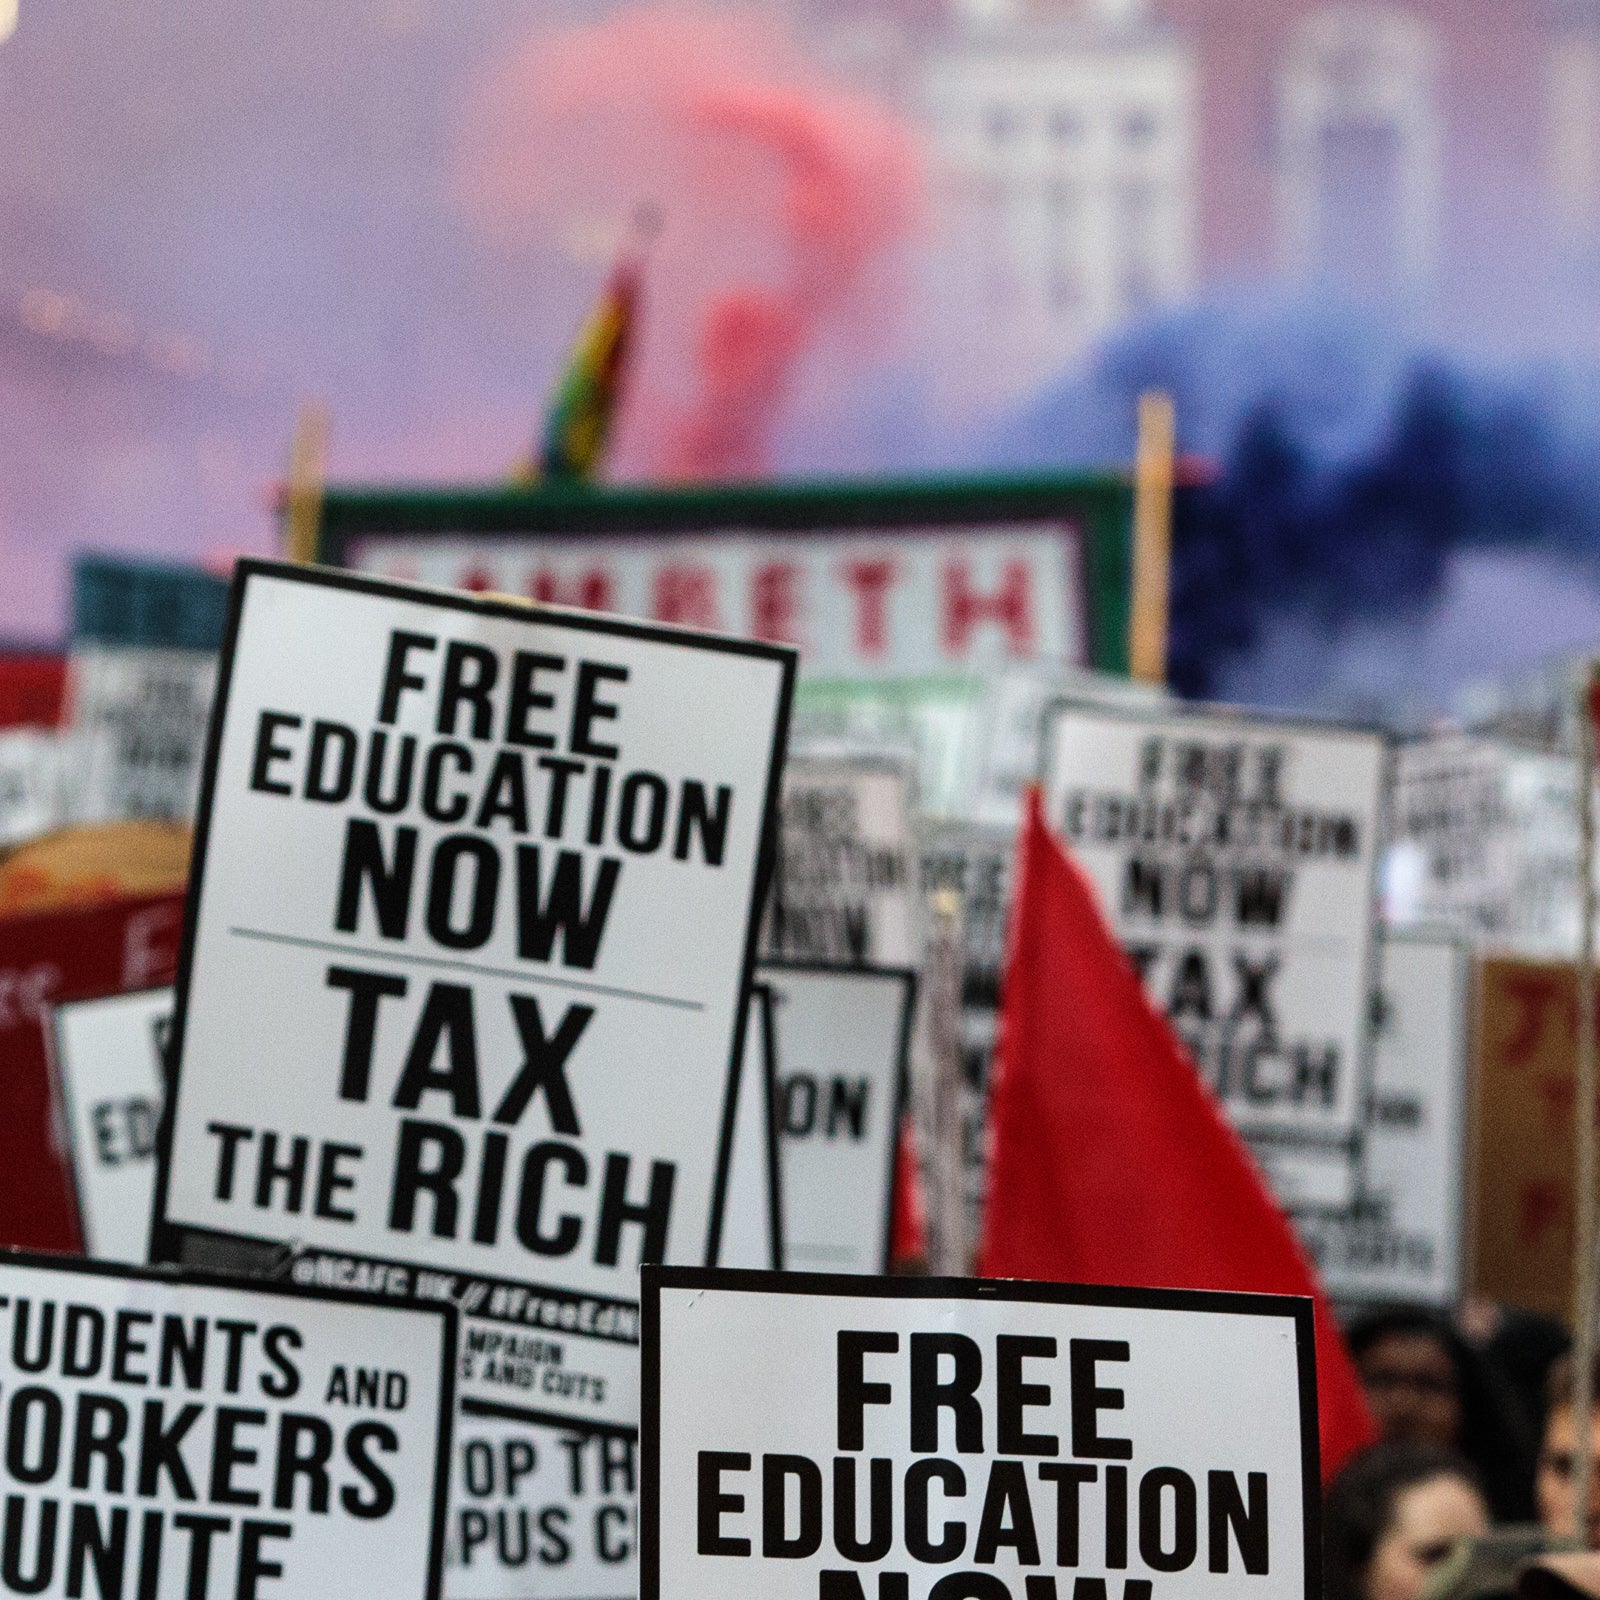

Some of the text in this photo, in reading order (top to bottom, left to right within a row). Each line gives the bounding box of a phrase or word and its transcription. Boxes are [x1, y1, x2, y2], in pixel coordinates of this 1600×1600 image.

[378, 628, 631, 760] FREE
[248, 710, 732, 867] EDUCATION
[1138, 737, 1285, 806] FREE
[334, 817, 623, 970] NOW
[1122, 858, 1290, 928] NOW
[326, 965, 595, 1136] TAX
[206, 1122, 364, 1224] THE
[387, 1117, 676, 1272] RICH
[324, 1364, 409, 1413] AND
[836, 1330, 1133, 1460] FREE
[464, 1433, 638, 1499] OP TH
[697, 1449, 1270, 1575] EDUCATION
[460, 1506, 571, 1568] PUS
